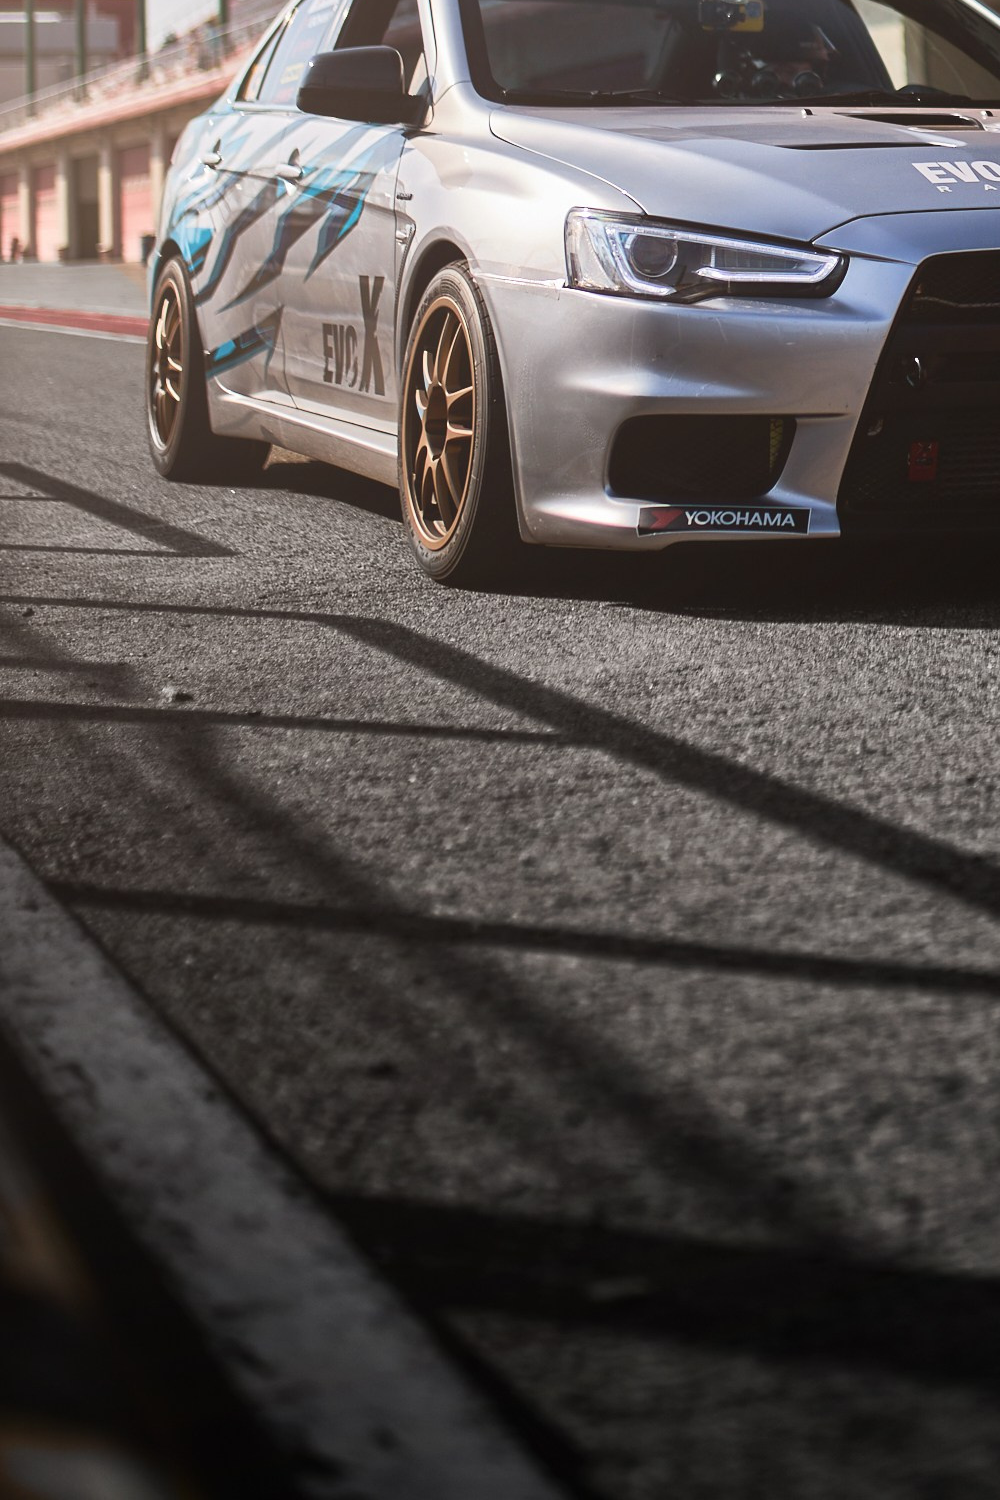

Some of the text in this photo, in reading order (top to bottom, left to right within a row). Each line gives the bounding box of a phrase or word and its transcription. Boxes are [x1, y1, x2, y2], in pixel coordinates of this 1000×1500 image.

[322, 274, 386, 397] EVO X
[684, 510, 796, 528] YOKOHAMA
